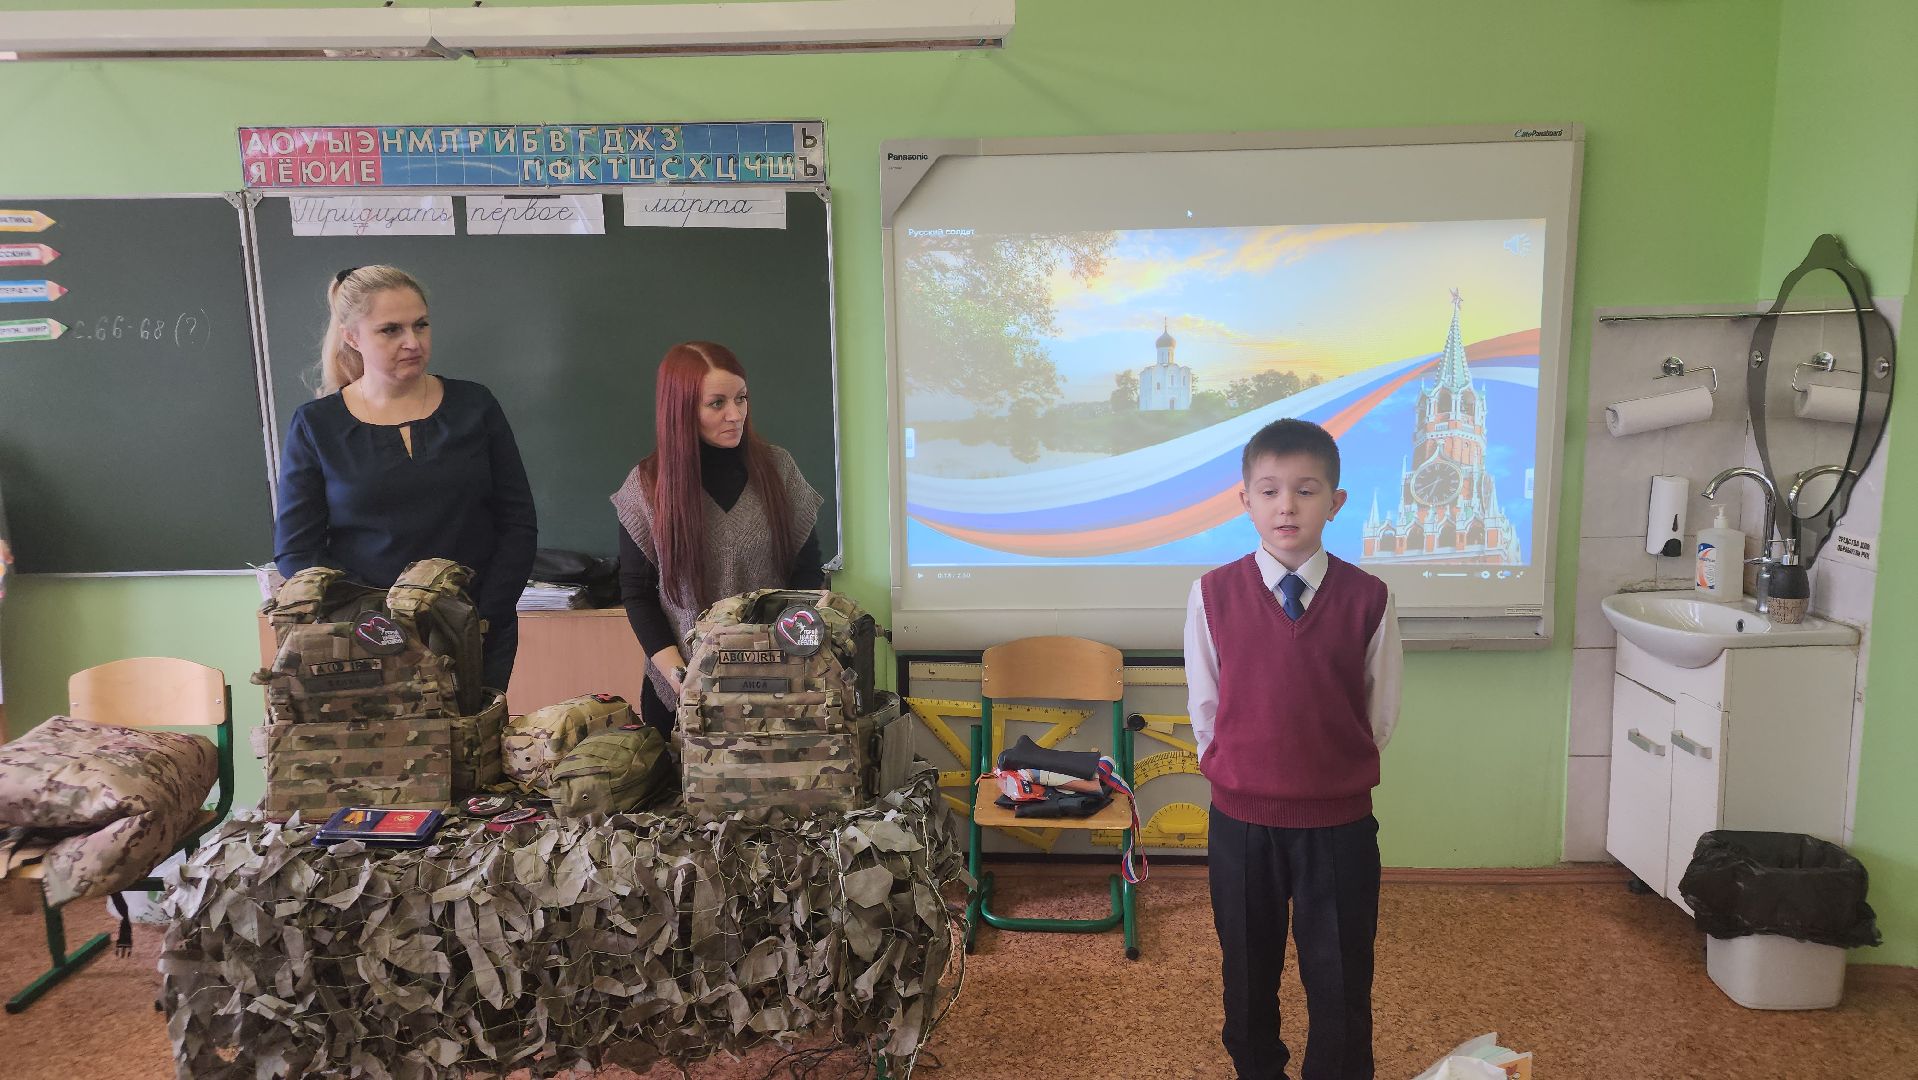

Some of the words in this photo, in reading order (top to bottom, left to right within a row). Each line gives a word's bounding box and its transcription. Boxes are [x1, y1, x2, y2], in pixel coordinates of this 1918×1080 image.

[887, 152, 929, 161] Panasonic
[293, 198, 453, 236] Тридцать
[471, 198, 574, 235] первое
[644, 198, 753, 228] марта
[908, 228, 944, 238] Русский
[945, 229, 976, 237] солдат
[722, 651, 756, 662] AB(IV)
